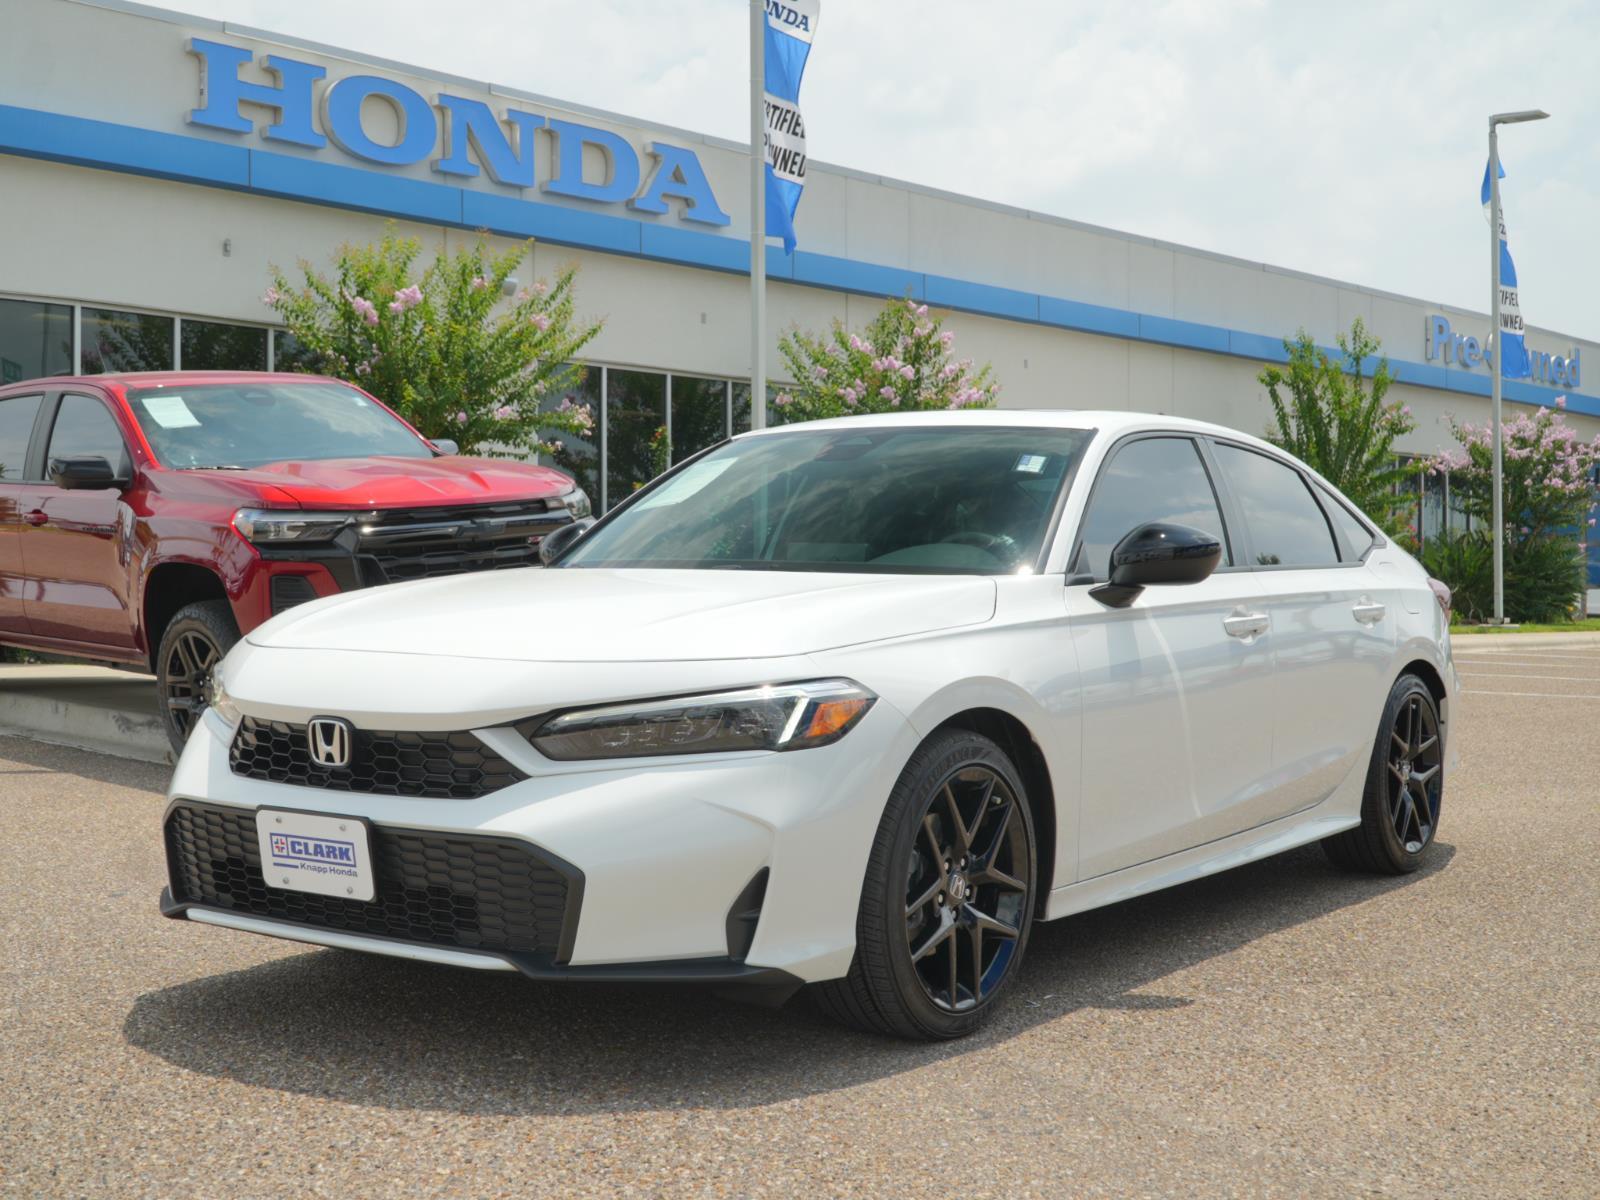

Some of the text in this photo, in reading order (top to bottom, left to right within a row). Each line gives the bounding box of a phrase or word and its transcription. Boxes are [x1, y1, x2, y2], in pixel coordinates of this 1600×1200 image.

[766, 0, 810, 32] NDA
[186, 37, 730, 226] HONDA
[1427, 315, 1580, 388] Pre-ned
[290, 840, 352, 861] CLARK
[299, 863, 358, 877] Knapp Honda
